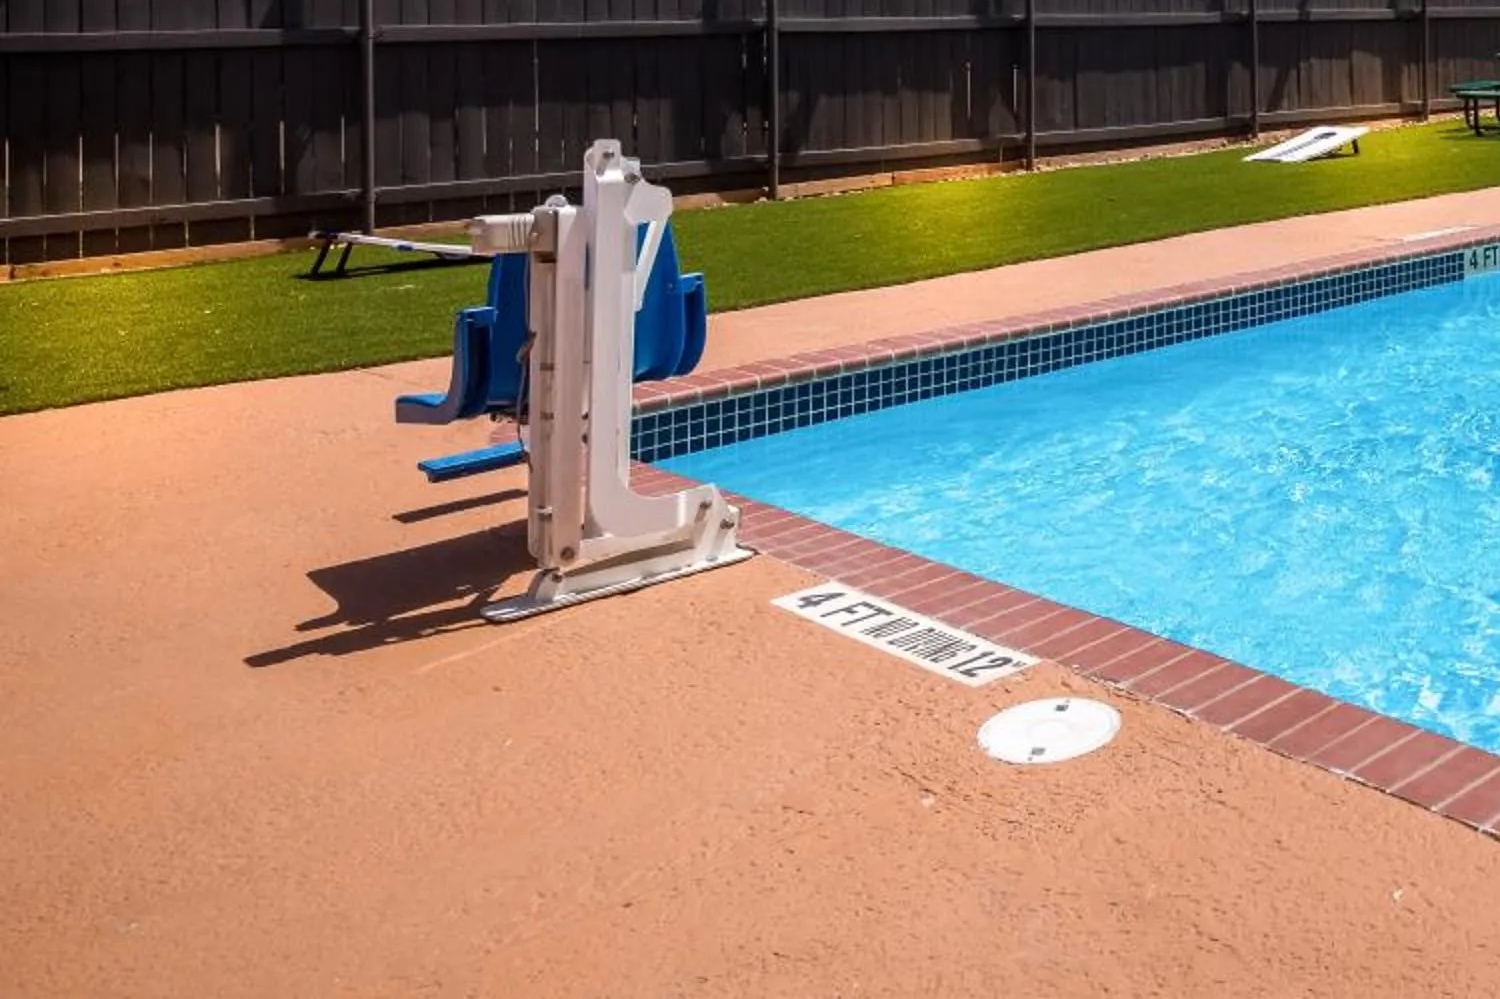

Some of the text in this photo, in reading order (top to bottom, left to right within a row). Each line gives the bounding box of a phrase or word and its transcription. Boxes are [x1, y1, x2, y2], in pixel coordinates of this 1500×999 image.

[1470, 246, 1499, 270] 4 FT
[797, 592, 846, 609] 4
[819, 601, 894, 626] FT
